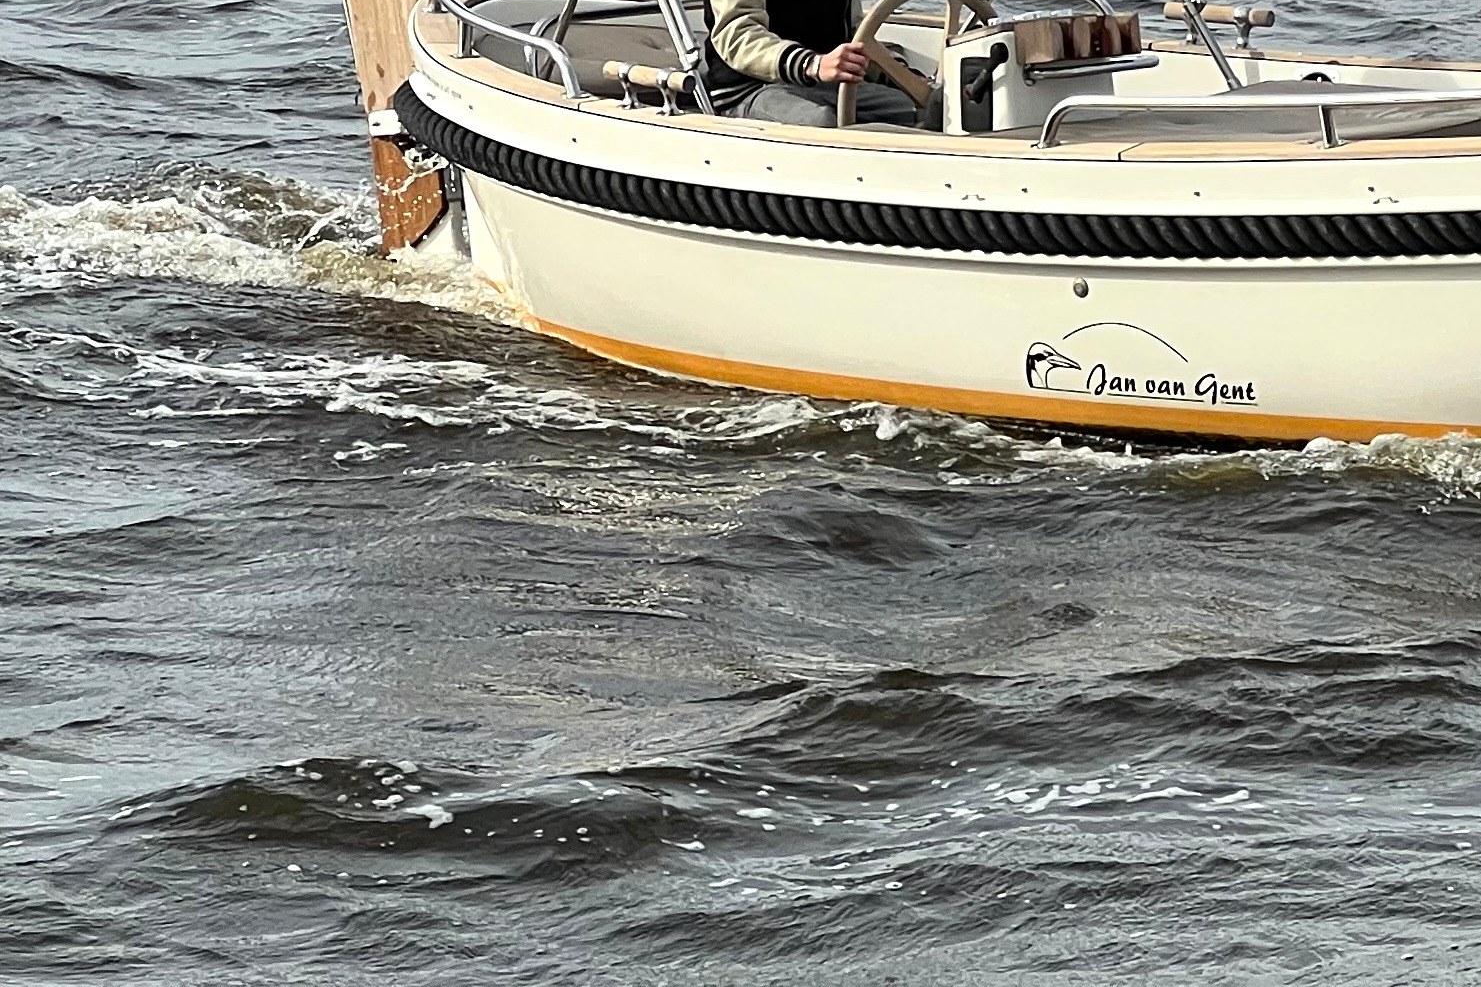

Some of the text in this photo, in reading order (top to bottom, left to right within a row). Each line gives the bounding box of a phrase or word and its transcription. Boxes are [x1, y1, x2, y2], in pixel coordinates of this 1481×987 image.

[1086, 363, 1256, 406] Jan van Gent
